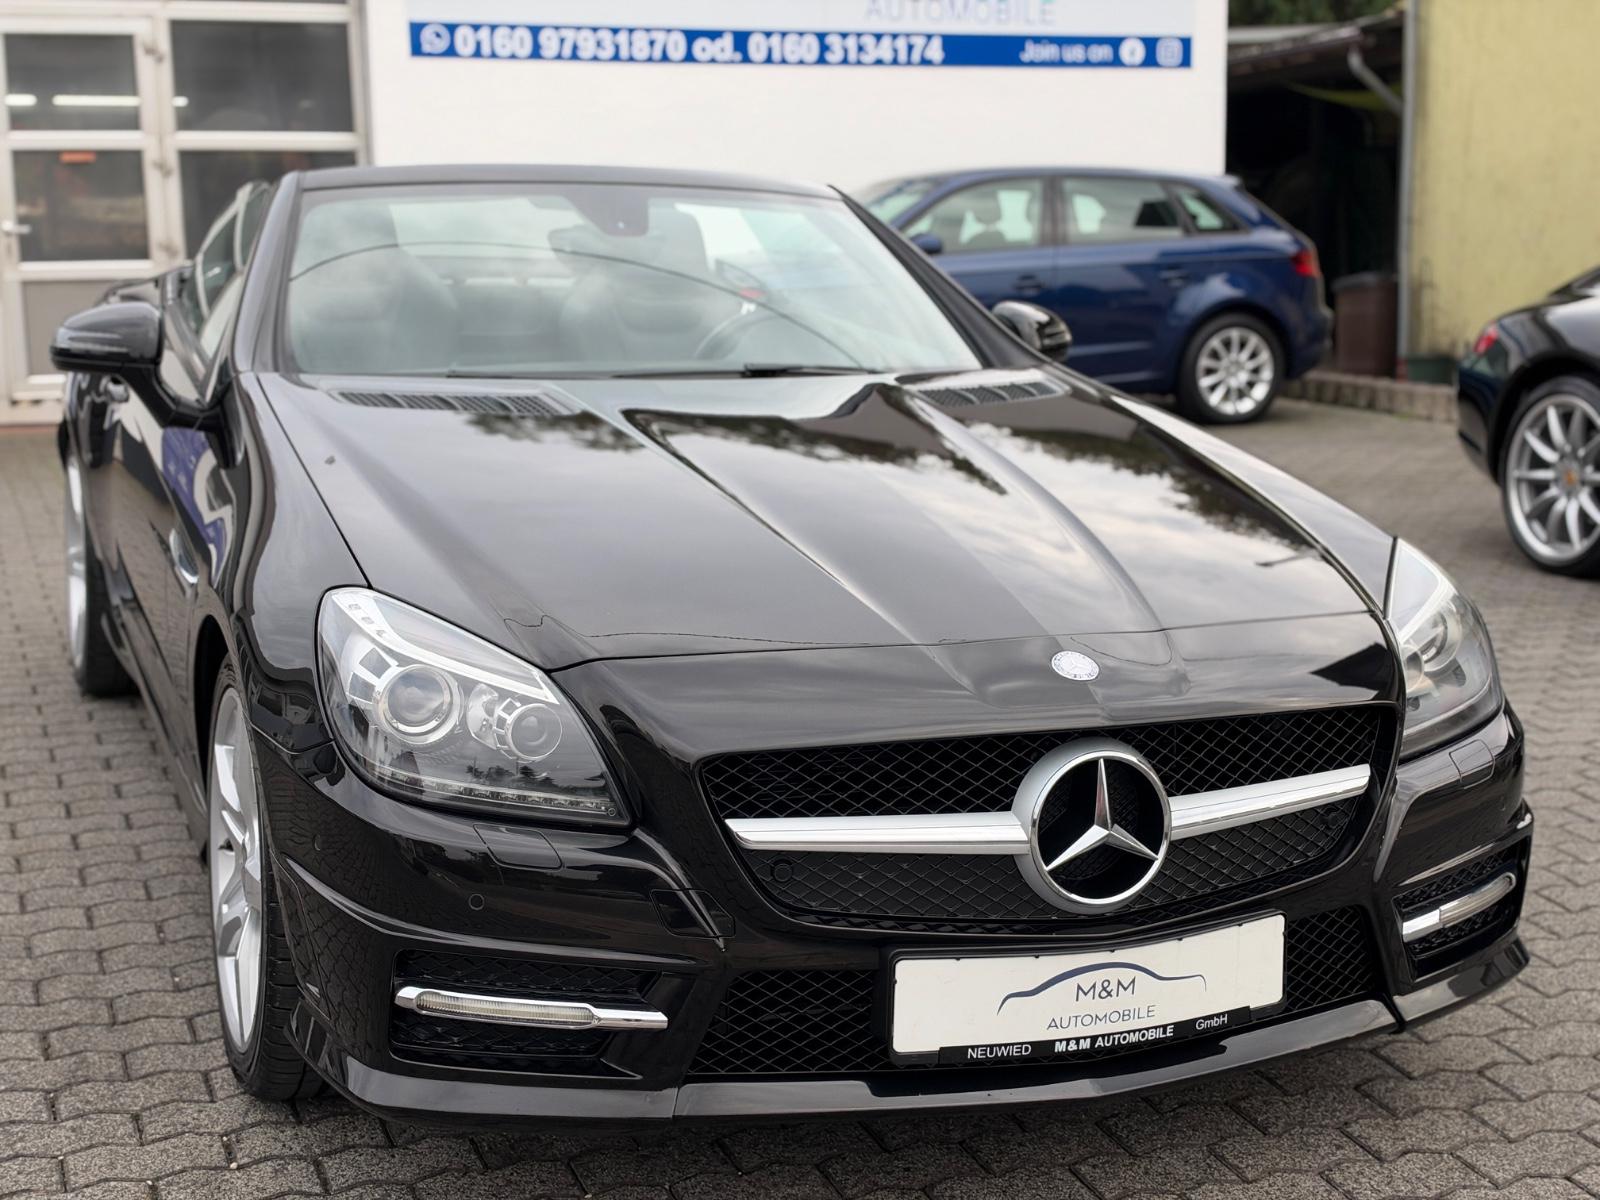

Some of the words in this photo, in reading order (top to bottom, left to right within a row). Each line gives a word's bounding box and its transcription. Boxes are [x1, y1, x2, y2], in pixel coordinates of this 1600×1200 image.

[453, 25, 534, 58] 0160
[538, 27, 687, 61] 97931870
[691, 31, 743, 62] od.
[747, 32, 821, 63] 0160
[824, 33, 945, 65] 3134174
[1019, 39, 1060, 63] Join
[1062, 44, 1085, 62] us
[1086, 44, 1114, 63] on
[1075, 976, 1136, 1002] M&M
[1047, 1005, 1155, 1029] AUTOMOBILE
[967, 1044, 1032, 1060] NEUWIED
[1095, 1025, 1174, 1048] AUTOMOBILE
[1195, 1014, 1228, 1030] GmbH
